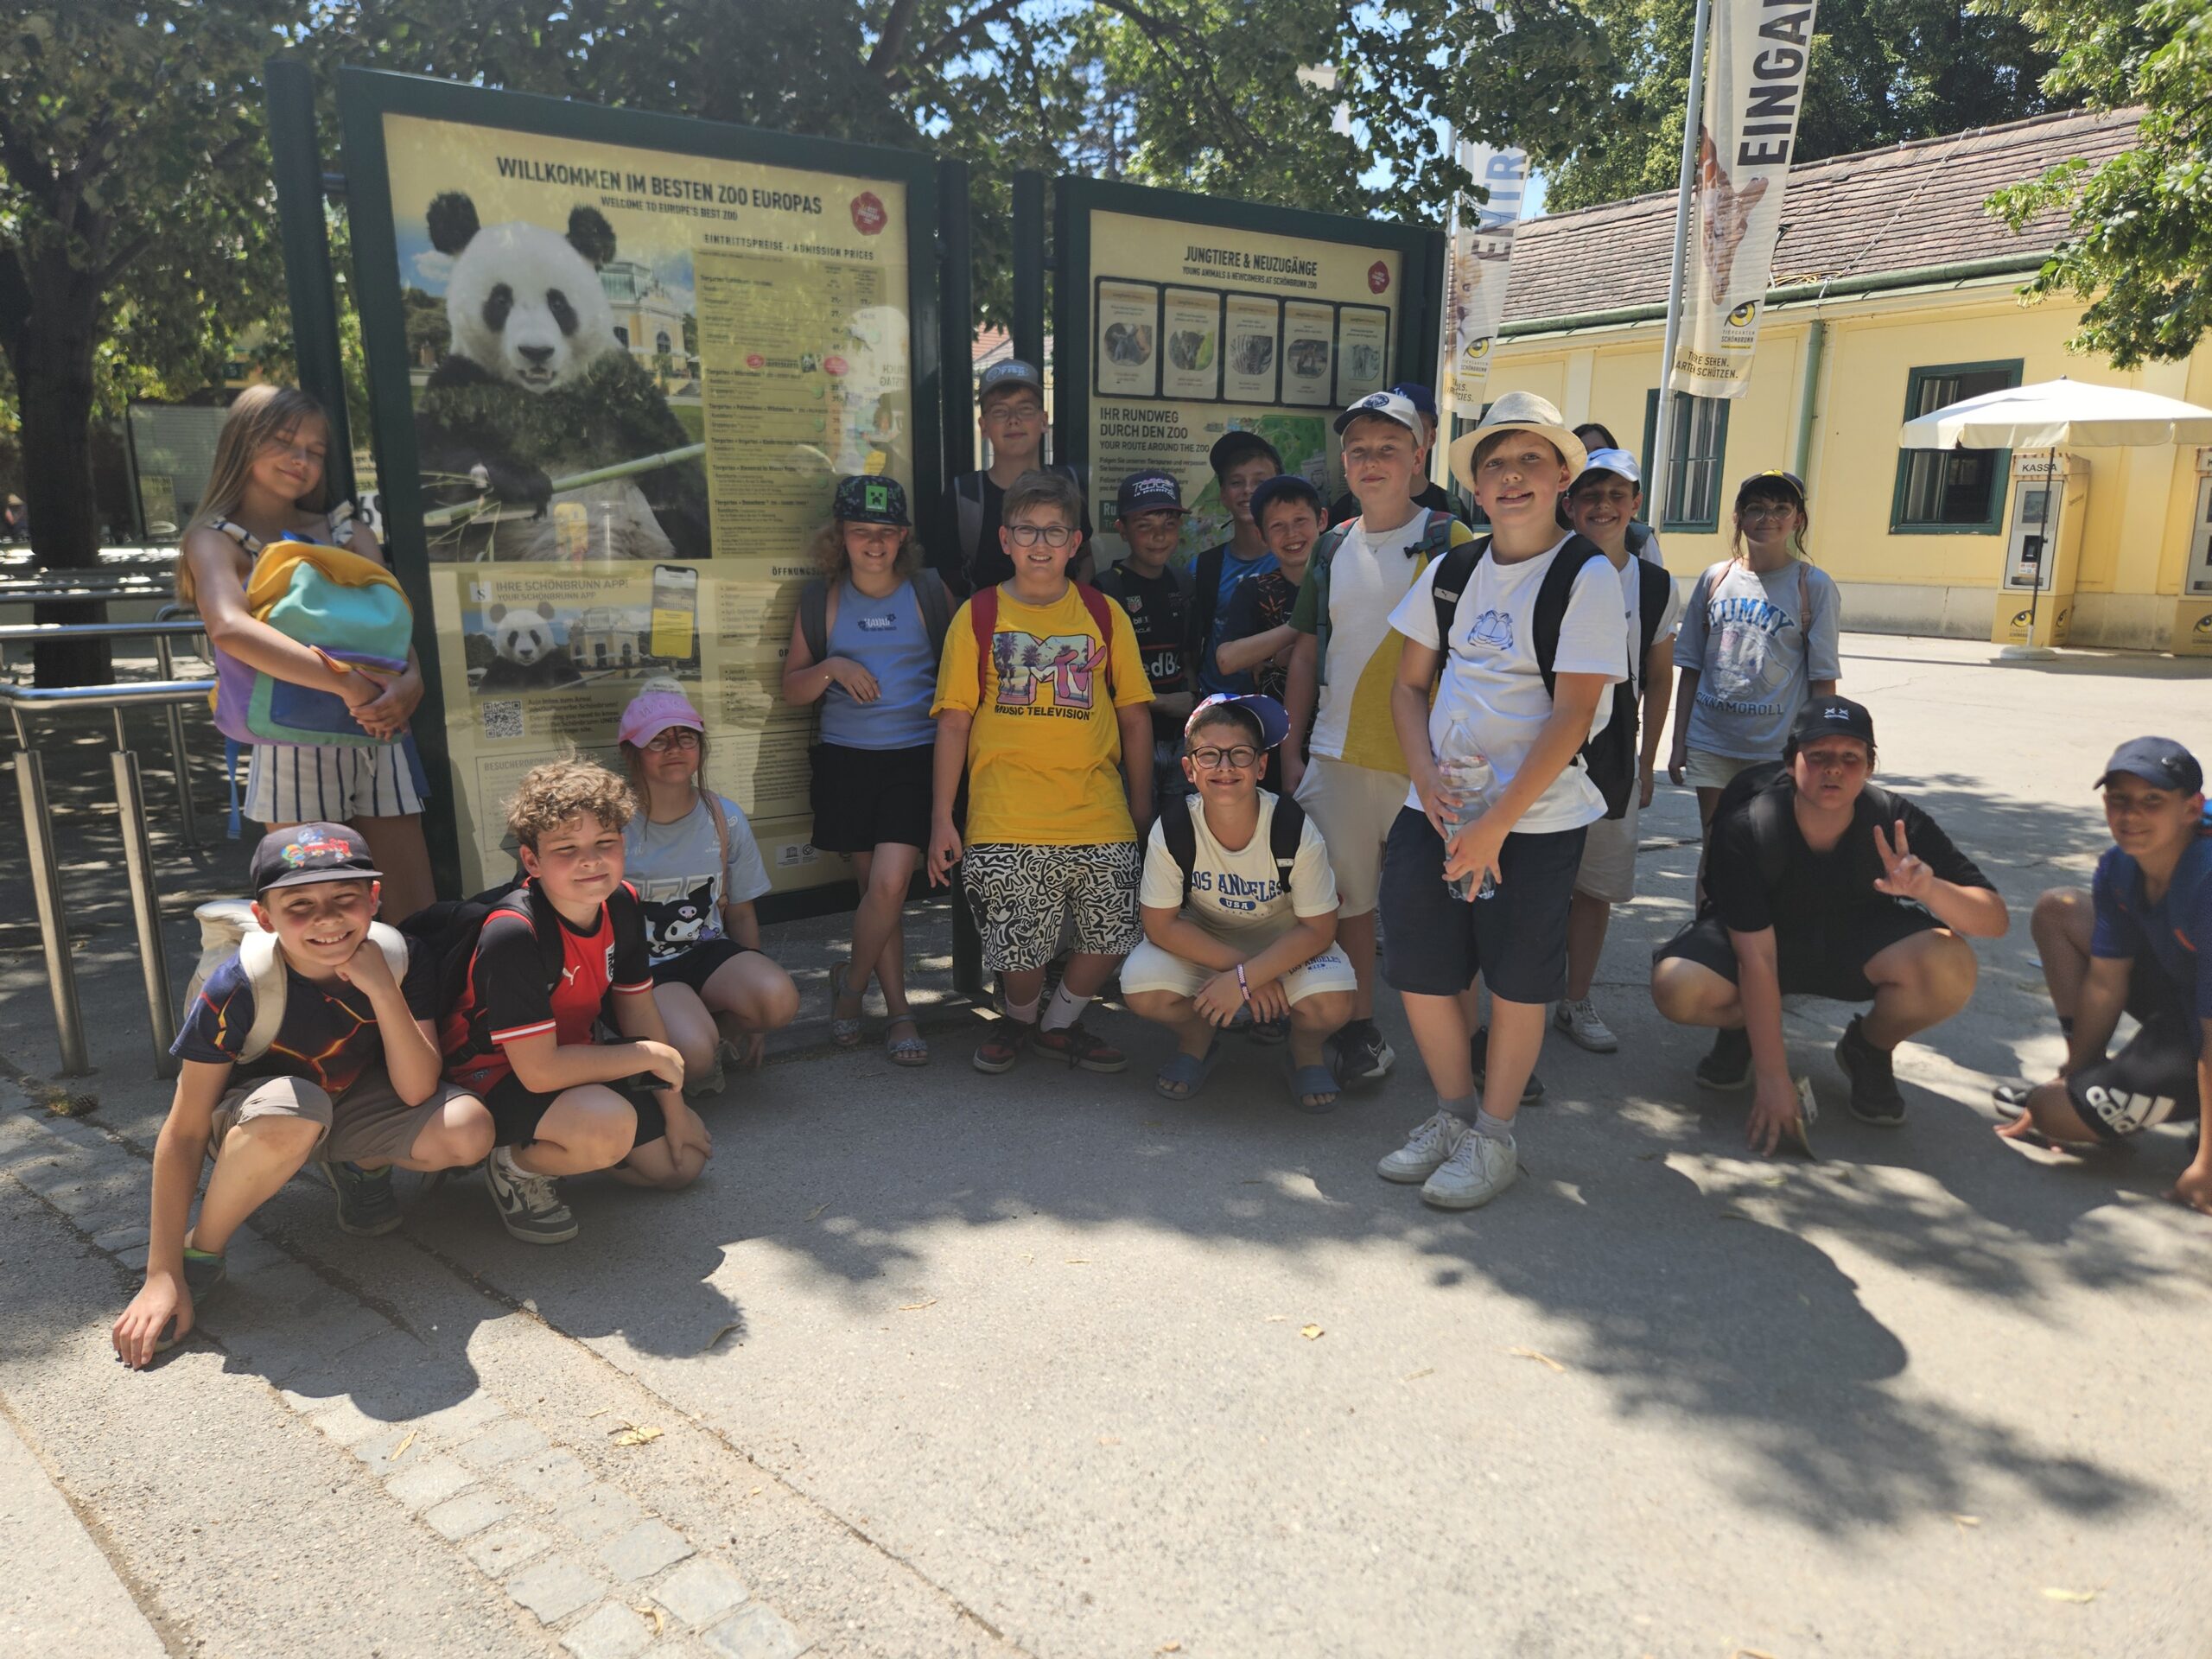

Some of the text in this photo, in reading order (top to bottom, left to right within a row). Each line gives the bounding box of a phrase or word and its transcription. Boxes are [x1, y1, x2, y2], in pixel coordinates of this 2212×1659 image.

[1737, 0, 1813, 166] EINGA
[497, 156, 822, 214] WILLKOMMEN IM BESTEN ZOO EUROPAS
[601, 197, 738, 221] WELCOME TO EUROPE'S BEST ZOO
[1471, 155, 1527, 261] ENTR
[704, 233, 784, 251] EINTRITTSPREISE
[793, 244, 842, 258] ADMISSION
[844, 249, 874, 261] PRICES
[1185, 245, 1318, 276] JUNGTIERE & NEUZUGÄNGE
[1183, 266, 1200, 276] YOUNG
[1201, 268, 1225, 279] ANIMALS
[1231, 271, 1265, 283] NEWCOMERS
[1266, 276, 1272, 284] AT
[1273, 276, 1307, 289] SCHÖNBRUNN
[1307, 280, 1317, 289] ZOO
[1705, 356, 1729, 367] SEHEN.
[1697, 366, 1738, 378] SCHÜTZEN.
[1100, 407, 1179, 423] IHR RUNDWEG
[1100, 423, 1188, 439] DURCH DEN ZOO
[1100, 440, 1210, 453] YOUR ROUTE AROUND THE ZOO
[2022, 463, 2057, 472] KASSA
[772, 566, 821, 576] ÖFFNUNGS
[496, 581, 522, 592] IHRE
[498, 593, 521, 602] YOUR
[581, 591, 596, 600] APP
[1707, 597, 1795, 638] YUMMY
[1696, 691, 1784, 715] CINNAMOROLL
[995, 704, 1090, 721] MUSIC TELEVISION
[1218, 873, 1283, 903] ANGELES
[1225, 899, 1249, 910] USA
[1305, 955, 1342, 967] ANGELES
